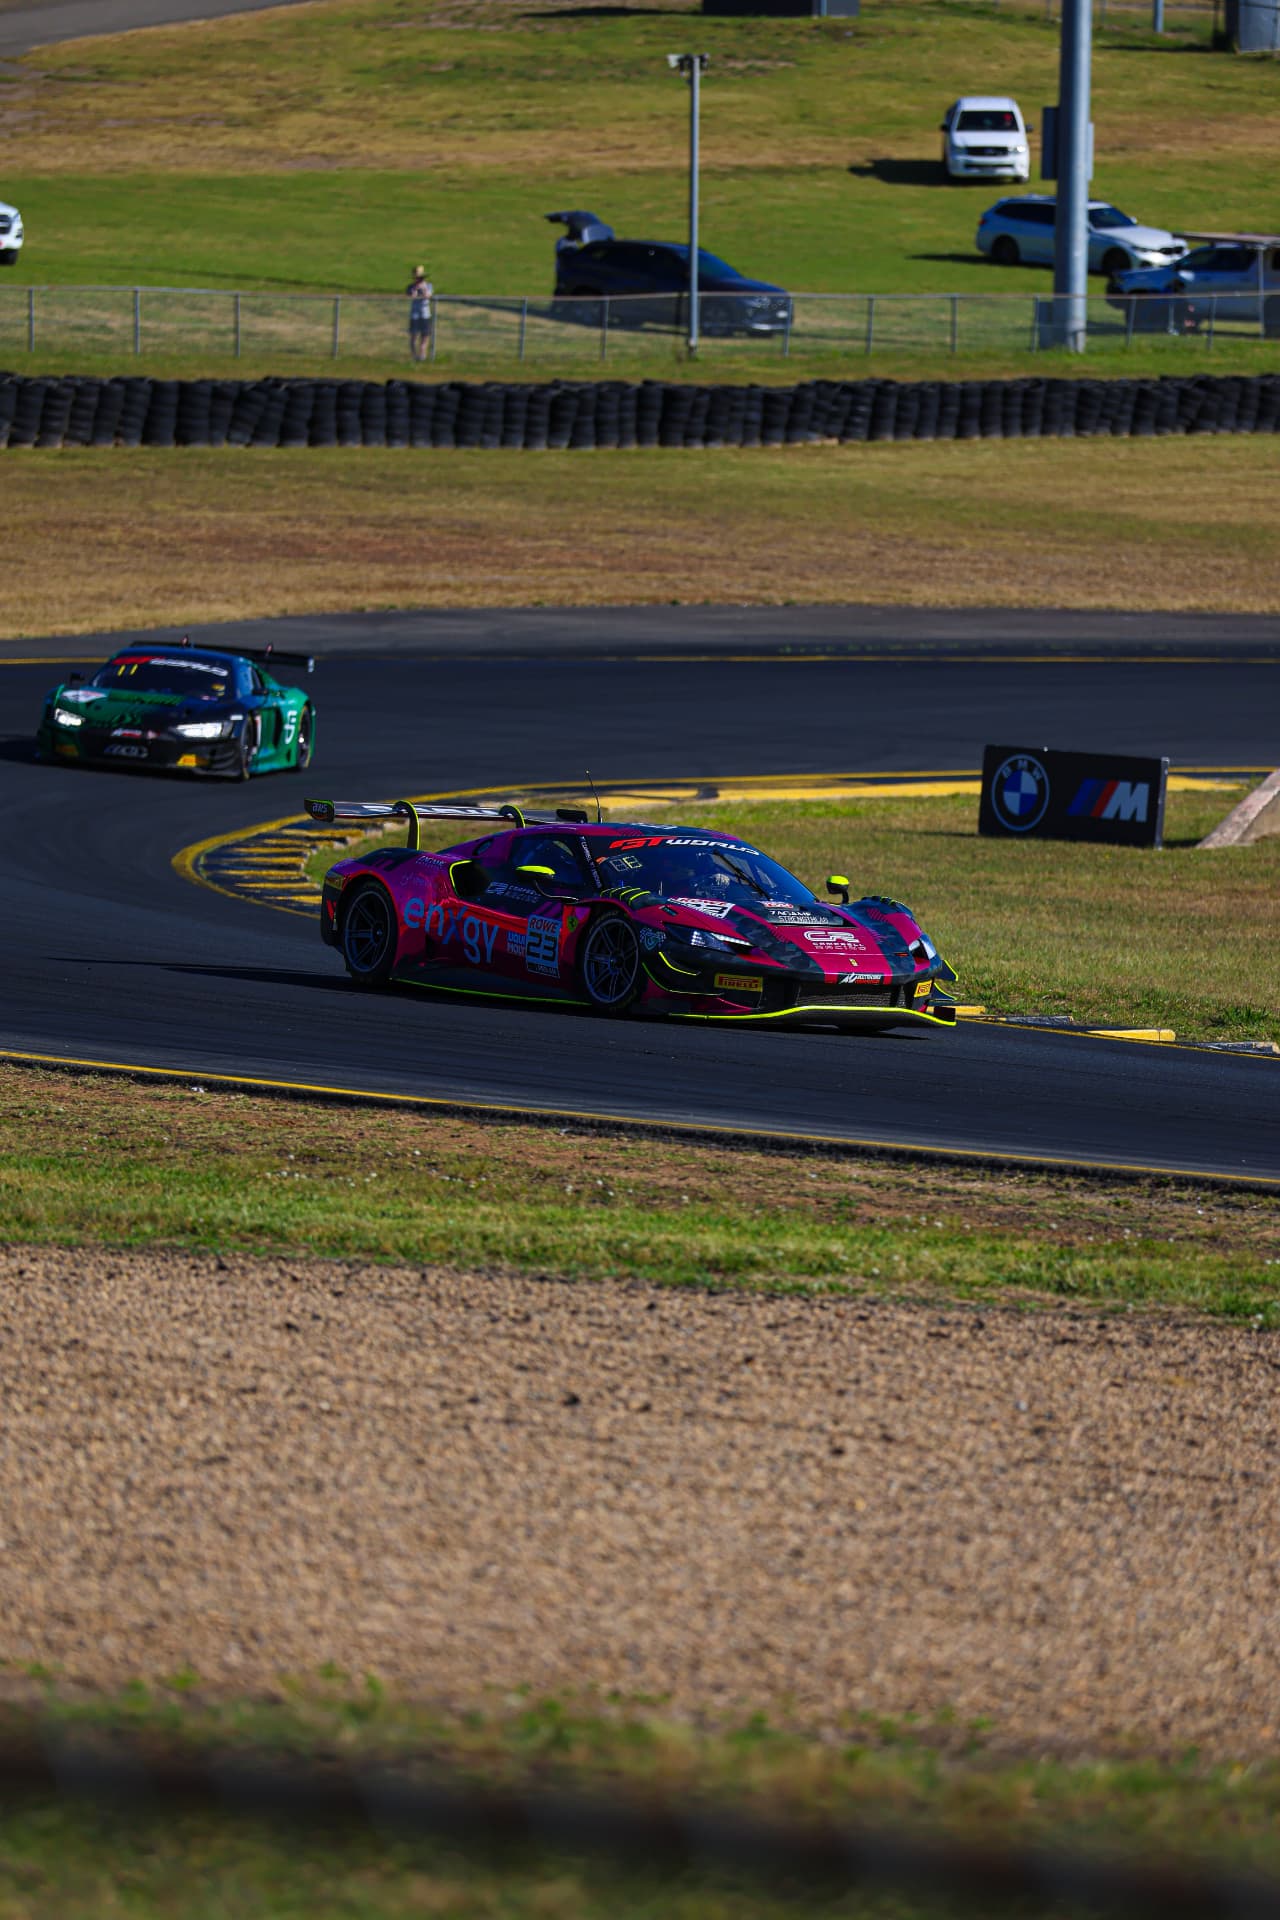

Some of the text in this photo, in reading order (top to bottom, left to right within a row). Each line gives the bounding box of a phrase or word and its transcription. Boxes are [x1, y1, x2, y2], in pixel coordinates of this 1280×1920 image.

[608, 836, 677, 851] GT
[529, 918, 557, 933] ROWE
[527, 931, 556, 961] 23
[719, 975, 759, 989] PIRELLI
